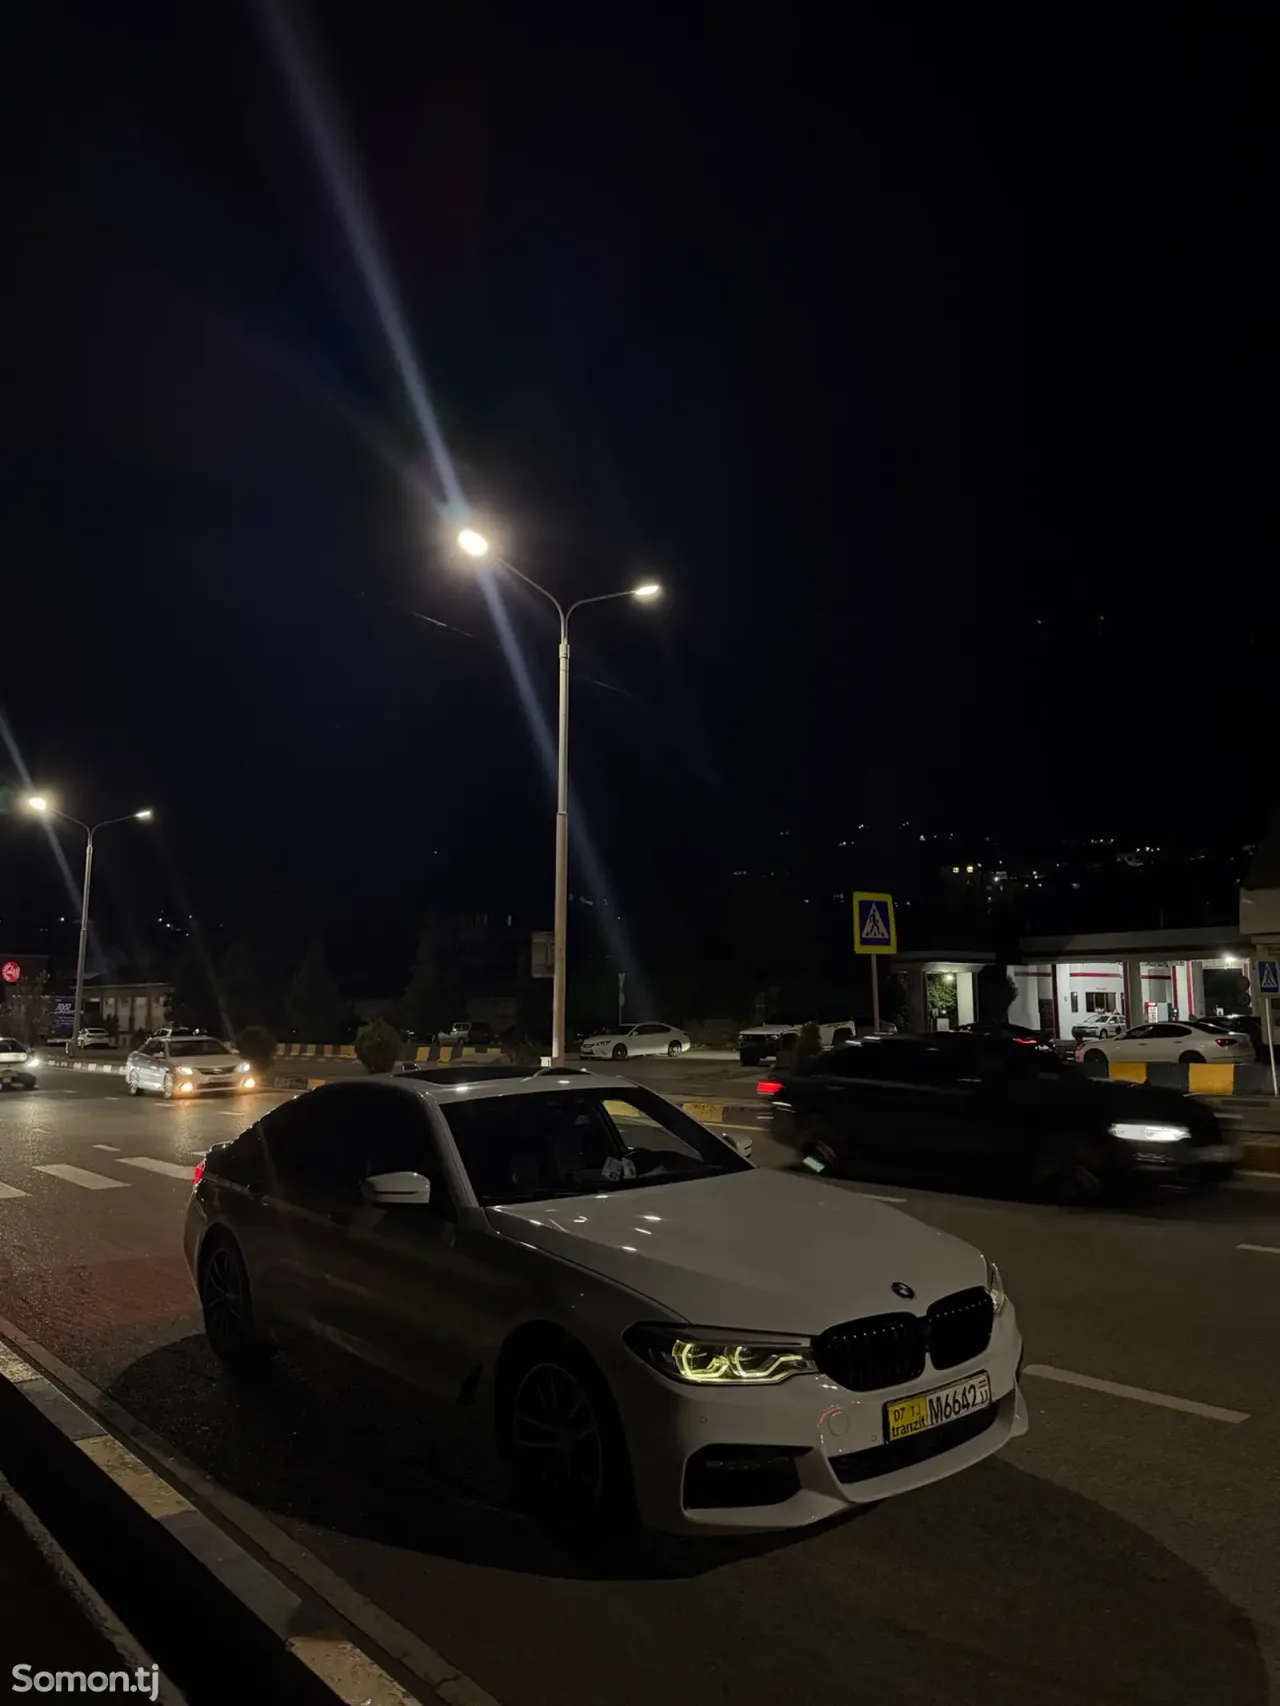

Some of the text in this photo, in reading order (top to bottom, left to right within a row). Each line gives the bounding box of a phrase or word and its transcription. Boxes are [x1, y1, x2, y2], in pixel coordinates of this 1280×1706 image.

[893, 1406, 906, 1422] 07
[928, 1384, 977, 1425] M6642
[891, 1416, 925, 1437] tranzit
